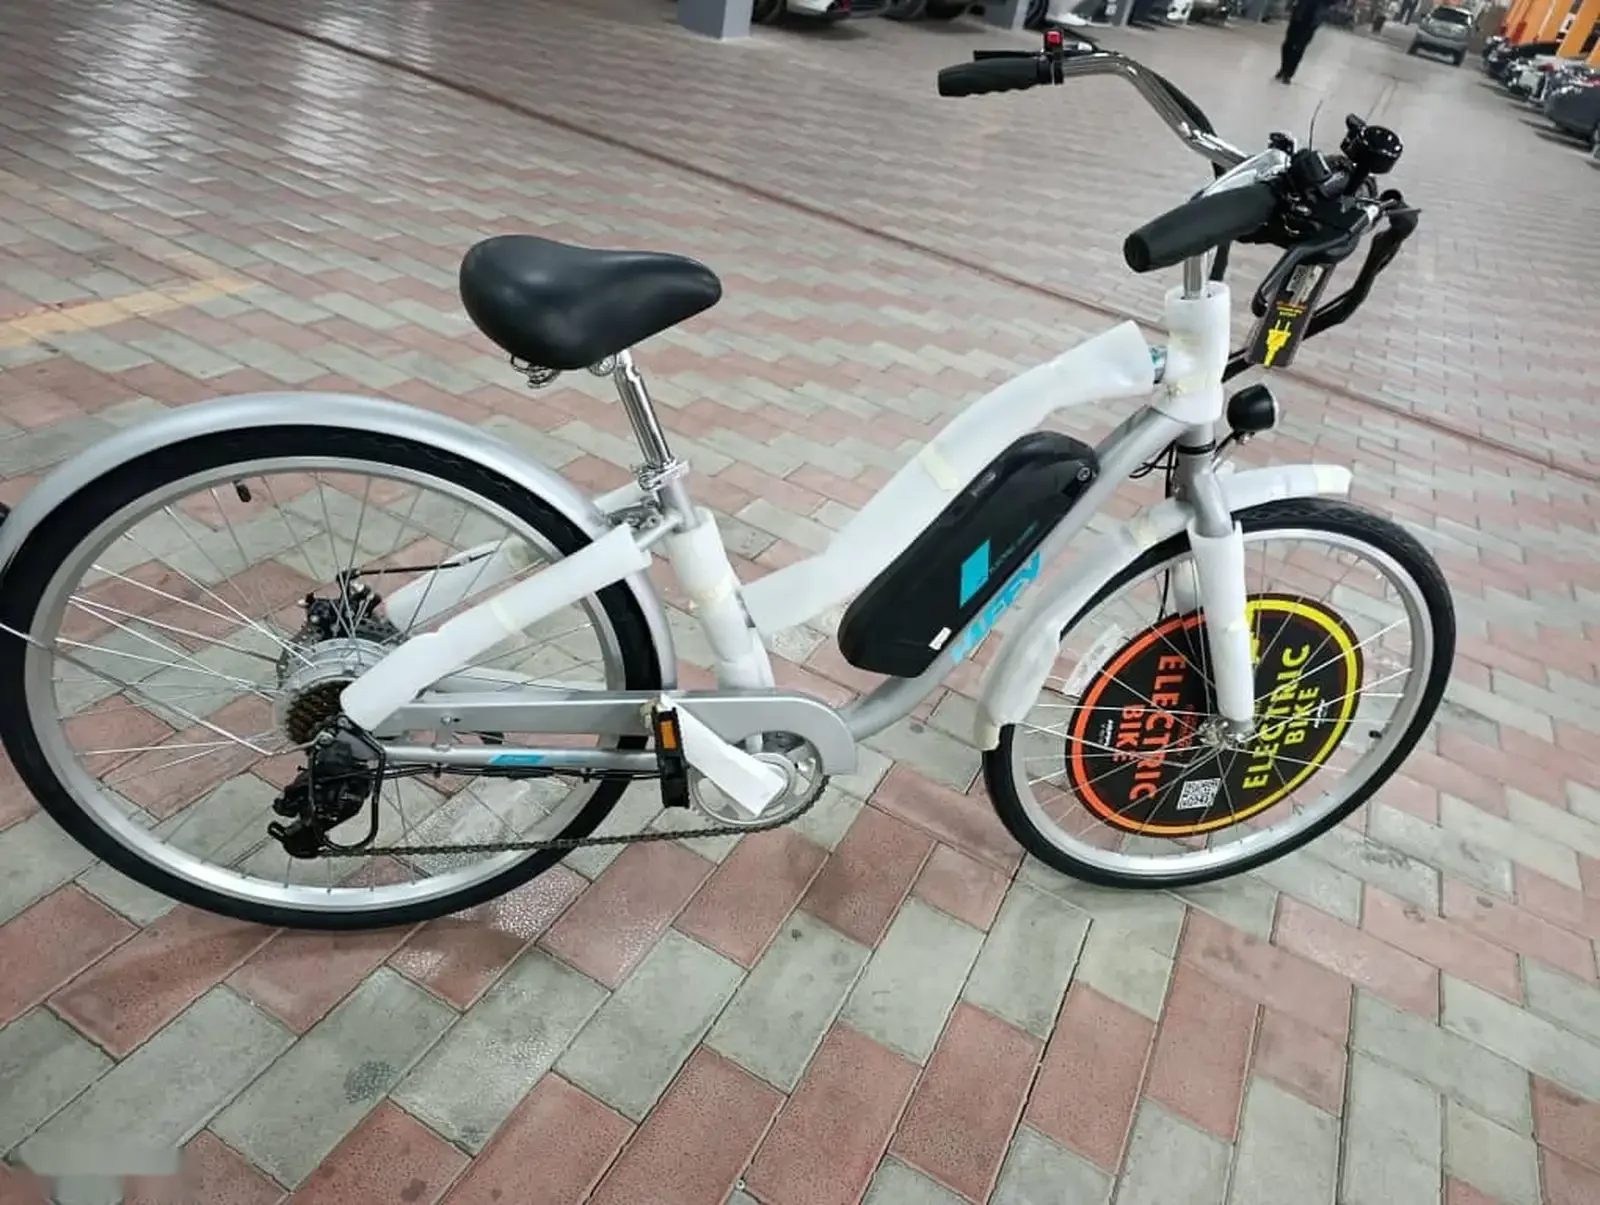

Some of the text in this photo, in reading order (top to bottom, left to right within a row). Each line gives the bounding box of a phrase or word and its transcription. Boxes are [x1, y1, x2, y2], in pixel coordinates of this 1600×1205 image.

[1111, 703, 1147, 763] BIKE
[1129, 654, 1187, 801] ELECTRIC
[1242, 643, 1311, 790] ELECTRIC
[1283, 686, 1320, 745] BIKE
